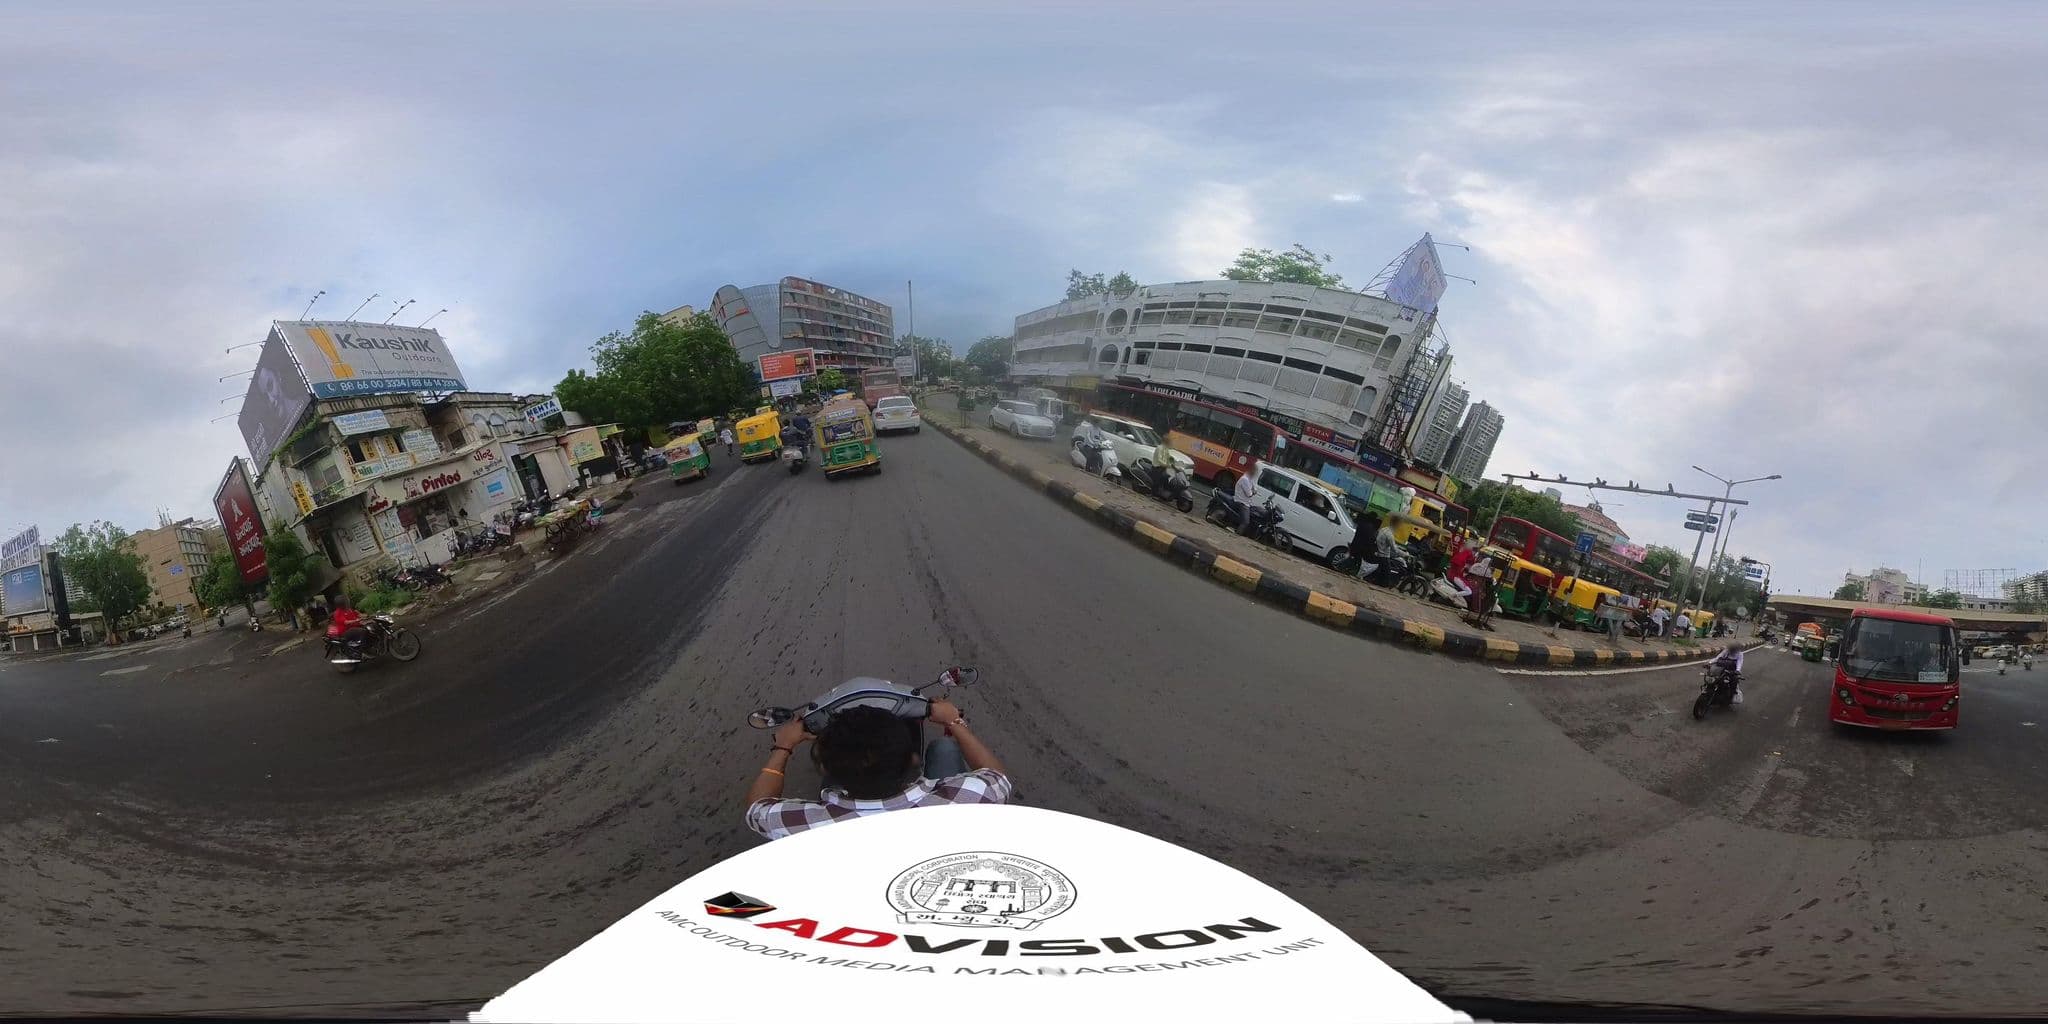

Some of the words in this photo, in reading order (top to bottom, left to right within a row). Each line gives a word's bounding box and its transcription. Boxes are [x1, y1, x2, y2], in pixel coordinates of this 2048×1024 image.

[335, 333, 436, 353] Kaushik
[392, 351, 442, 363] Outdoors
[340, 382, 354, 391] 88
[357, 380, 369, 390] 66
[370, 379, 384, 389] 00
[526, 399, 556, 417] MEHTA
[537, 407, 560, 419] HOSPITAL
[1311, 428, 1329, 438] TITAN
[1328, 444, 1345, 453] TIME
